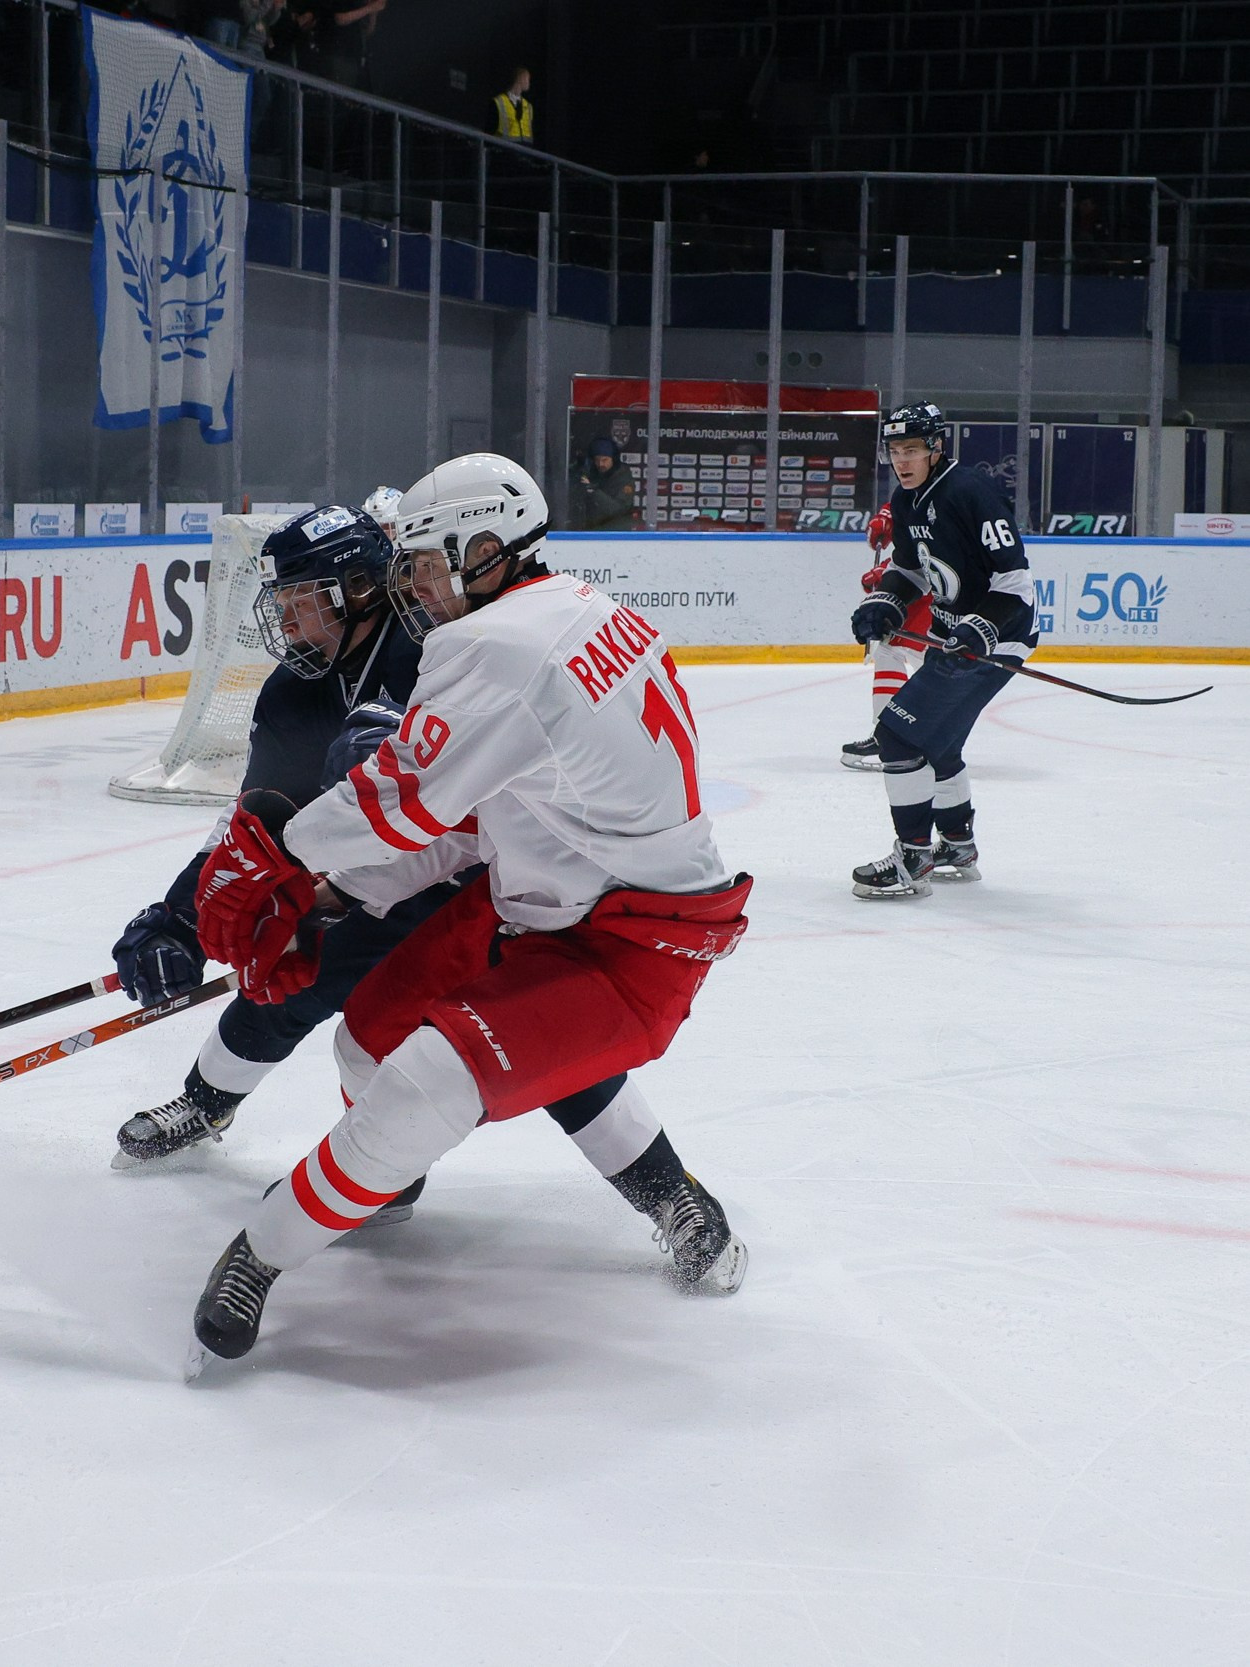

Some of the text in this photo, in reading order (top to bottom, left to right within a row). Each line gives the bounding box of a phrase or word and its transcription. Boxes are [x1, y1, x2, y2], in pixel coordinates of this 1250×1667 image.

[686, 429, 754, 441] МОЛОДЕЖНАЯ
[814, 430, 839, 442] ЛИГА
[963, 427, 970, 438] 9
[1056, 428, 1067, 440] 11
[1123, 430, 1133, 442] 12
[460, 505, 497, 519] CCM
[1047, 514, 1127, 534] PARI
[981, 519, 1015, 552] 46
[333, 545, 361, 564] CCM
[583, 569, 612, 584] ВХЛ
[606, 591, 736, 608] ЕЛКОВОГО ПУТИ
[1076, 572, 1148, 622] 50
[1129, 609, 1157, 621] ЛЕТ
[399, 704, 452, 770] 19
[641, 650, 701, 822] 1
[124, 994, 190, 1026] TRUE
[461, 1001, 512, 1071] TRUE
[24, 1047, 51, 1068] PX
